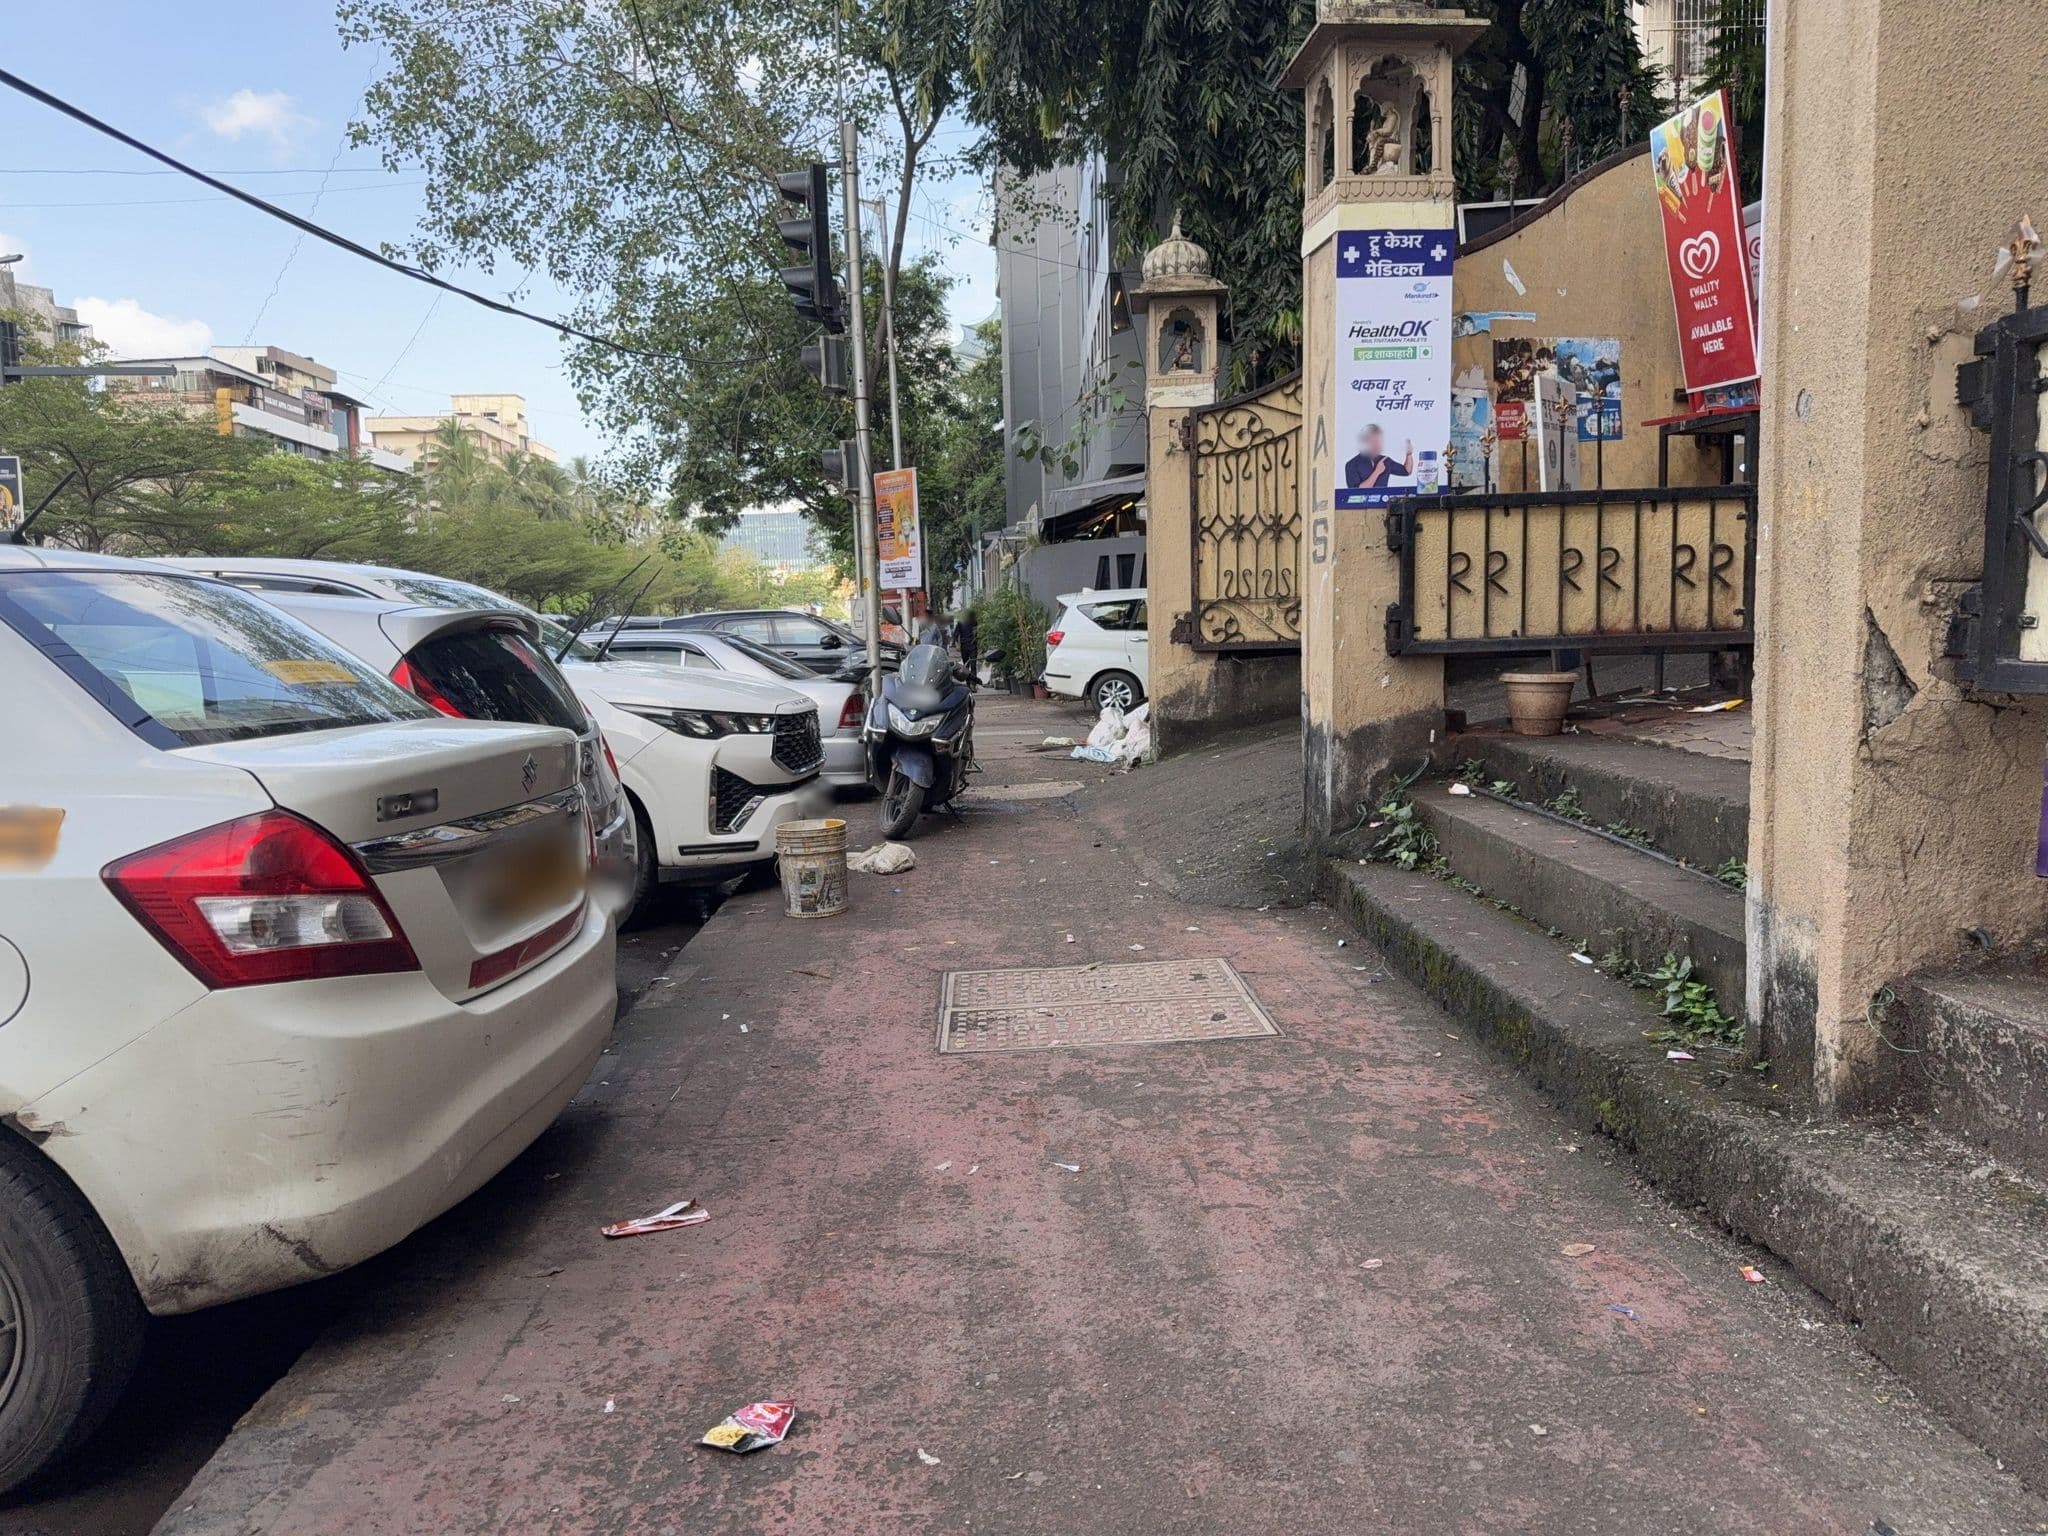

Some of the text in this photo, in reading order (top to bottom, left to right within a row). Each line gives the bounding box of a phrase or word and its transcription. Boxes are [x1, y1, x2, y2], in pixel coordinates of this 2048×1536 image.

[1384, 231, 1424, 248] केअर
[1364, 259, 1425, 276] मेडिकल
[1689, 279, 1720, 299] KWALITY
[1693, 295, 1718, 311] WALL'S
[1348, 320, 1432, 338] HealthOK
[1690, 316, 1734, 340] AVAILABLE
[1702, 338, 1725, 355] HERE
[1351, 379, 1407, 396] थकवा दूर
[1414, 400, 1435, 411] भरपूर
